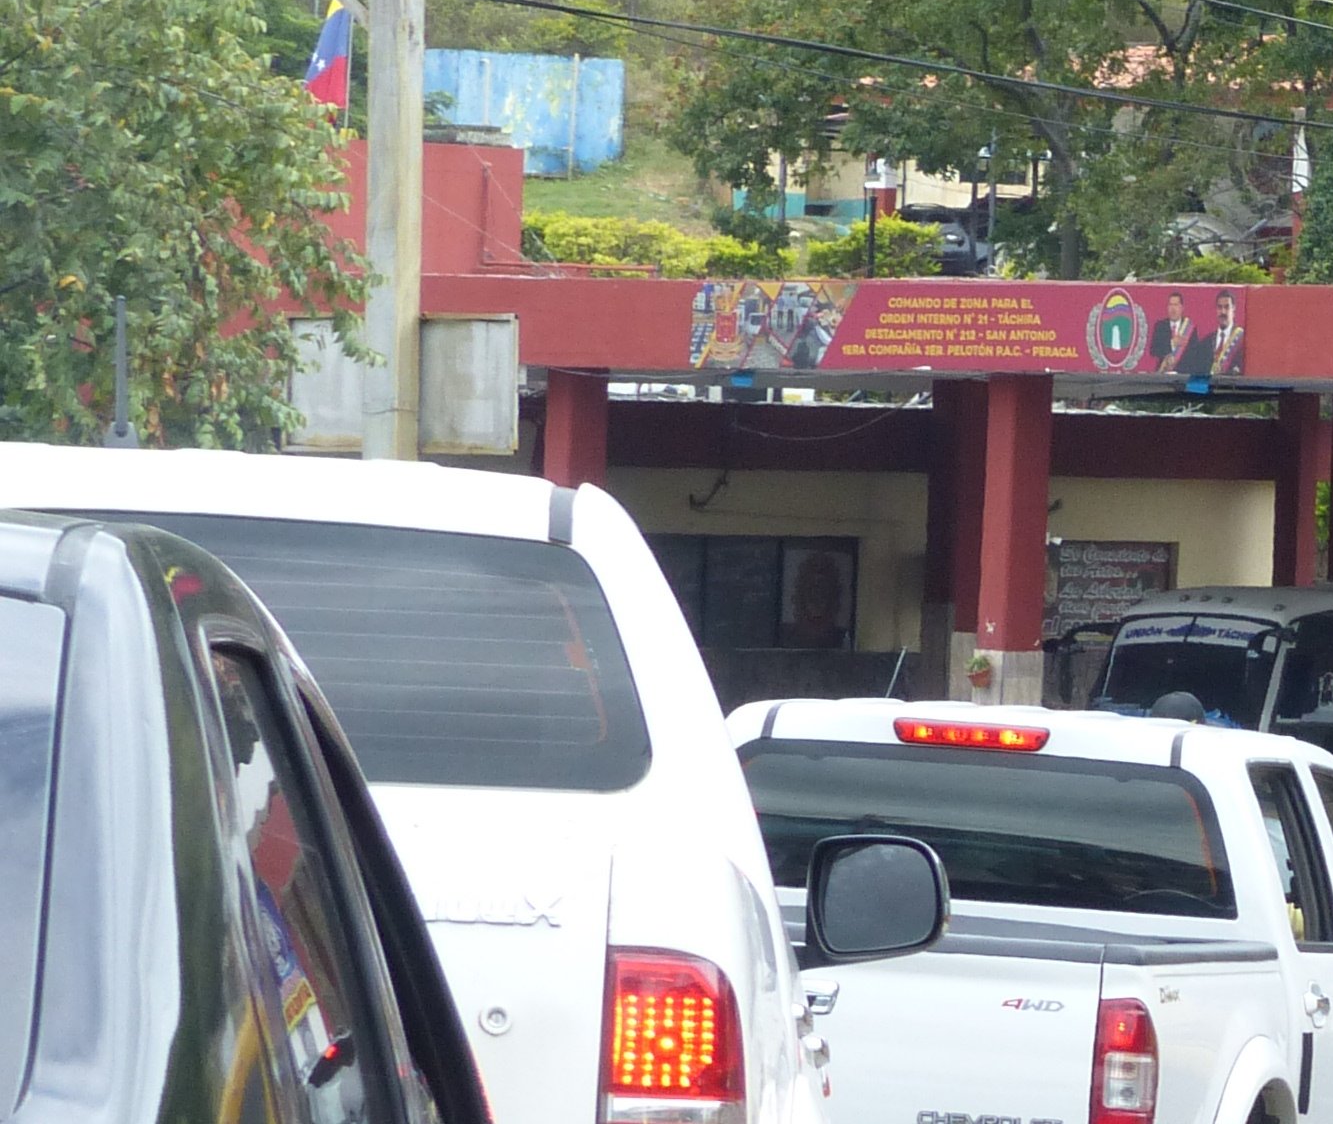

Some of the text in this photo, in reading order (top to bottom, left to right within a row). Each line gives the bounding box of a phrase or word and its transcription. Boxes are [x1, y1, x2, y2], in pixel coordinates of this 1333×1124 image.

[888, 298, 1034, 309] COMANDO DE ZONA PARA EL
[880, 314, 914, 324] ORDEN
[917, 314, 960, 324] INTERNO
[998, 312, 1041, 325] TÁCHIRA
[865, 329, 943, 340] DESTACAMENTO
[986, 330, 1006, 340] SAN
[1009, 330, 1056, 340] ANTONIO
[868, 342, 922, 355] COMPAÑÍA
[947, 343, 993, 356] PELOTÓN
[1032, 346, 1078, 357] PERACAL
[1001, 998, 1065, 1012] 4WD
